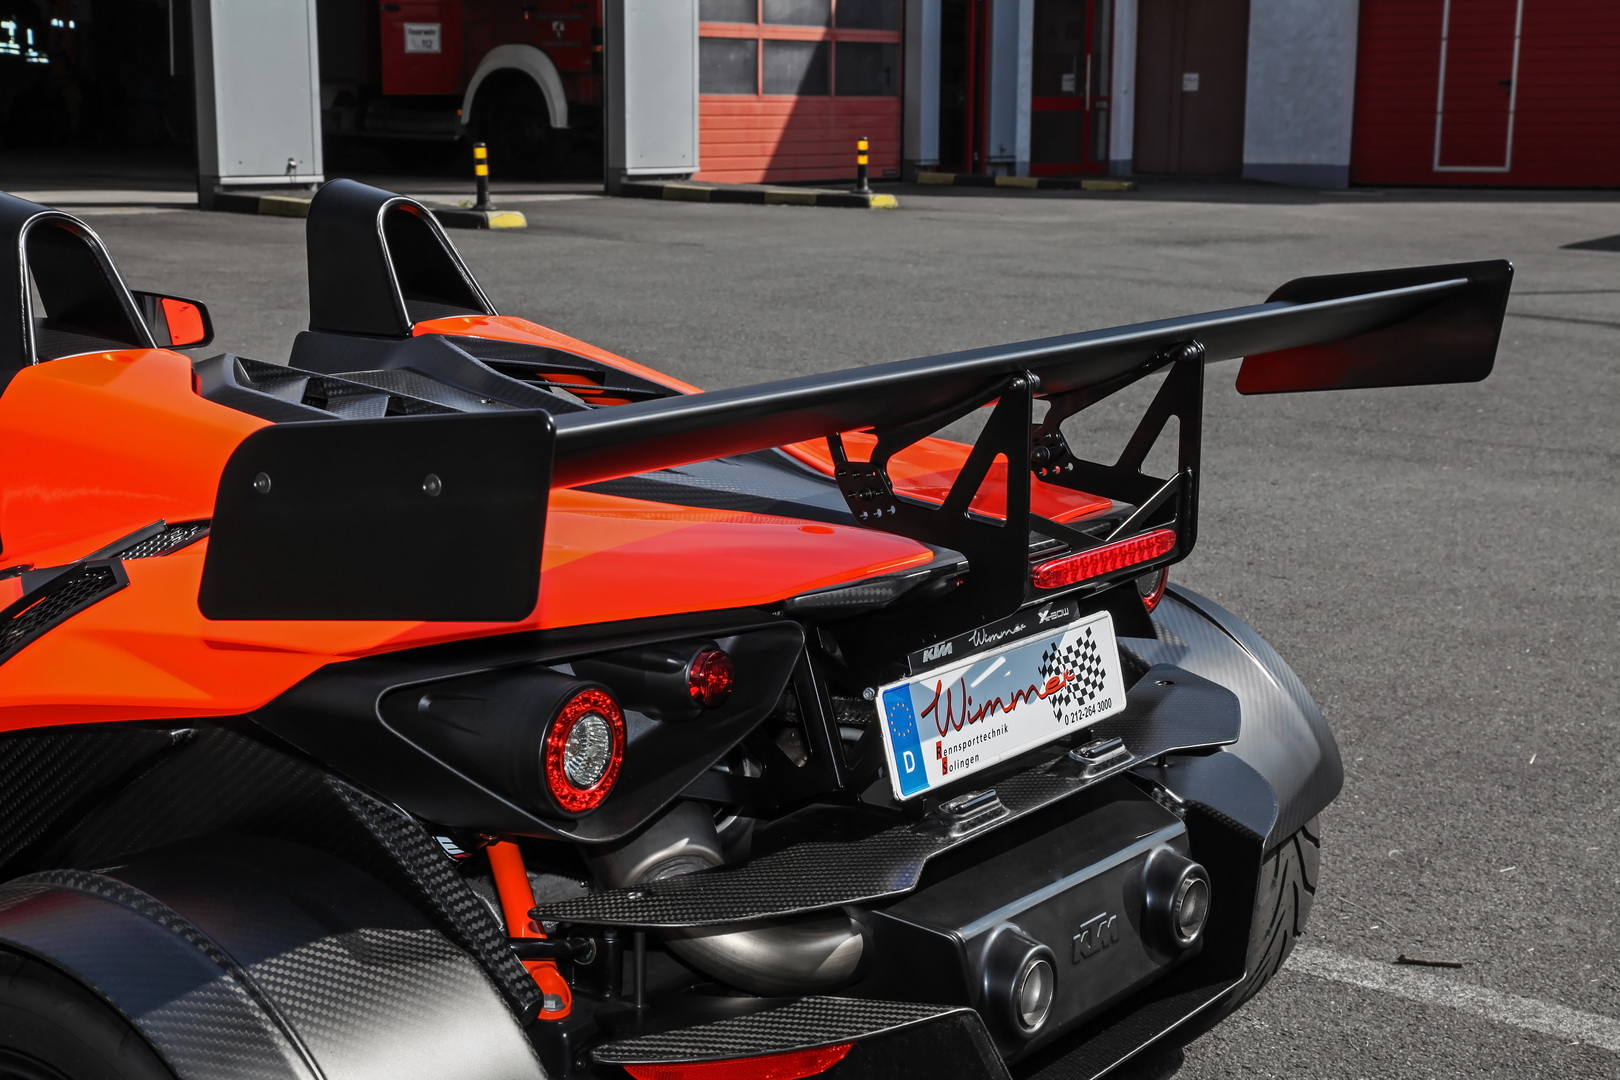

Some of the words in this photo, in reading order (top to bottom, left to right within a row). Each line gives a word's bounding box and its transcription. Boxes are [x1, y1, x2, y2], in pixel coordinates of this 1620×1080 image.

[421, 39, 433, 49] 112
[922, 640, 953, 663] KTM
[968, 623, 1027, 647] Wimmer
[920, 668, 1076, 737] Wimmer
[1064, 714, 1069, 726] 0
[1071, 704, 1096, 723] 212-264
[1097, 697, 1112, 713] 3000
[936, 723, 1009, 758] Rennsporttechnik
[903, 750, 916, 774] D
[942, 754, 980, 775] Solingen
[1072, 911, 1119, 965] KTM
